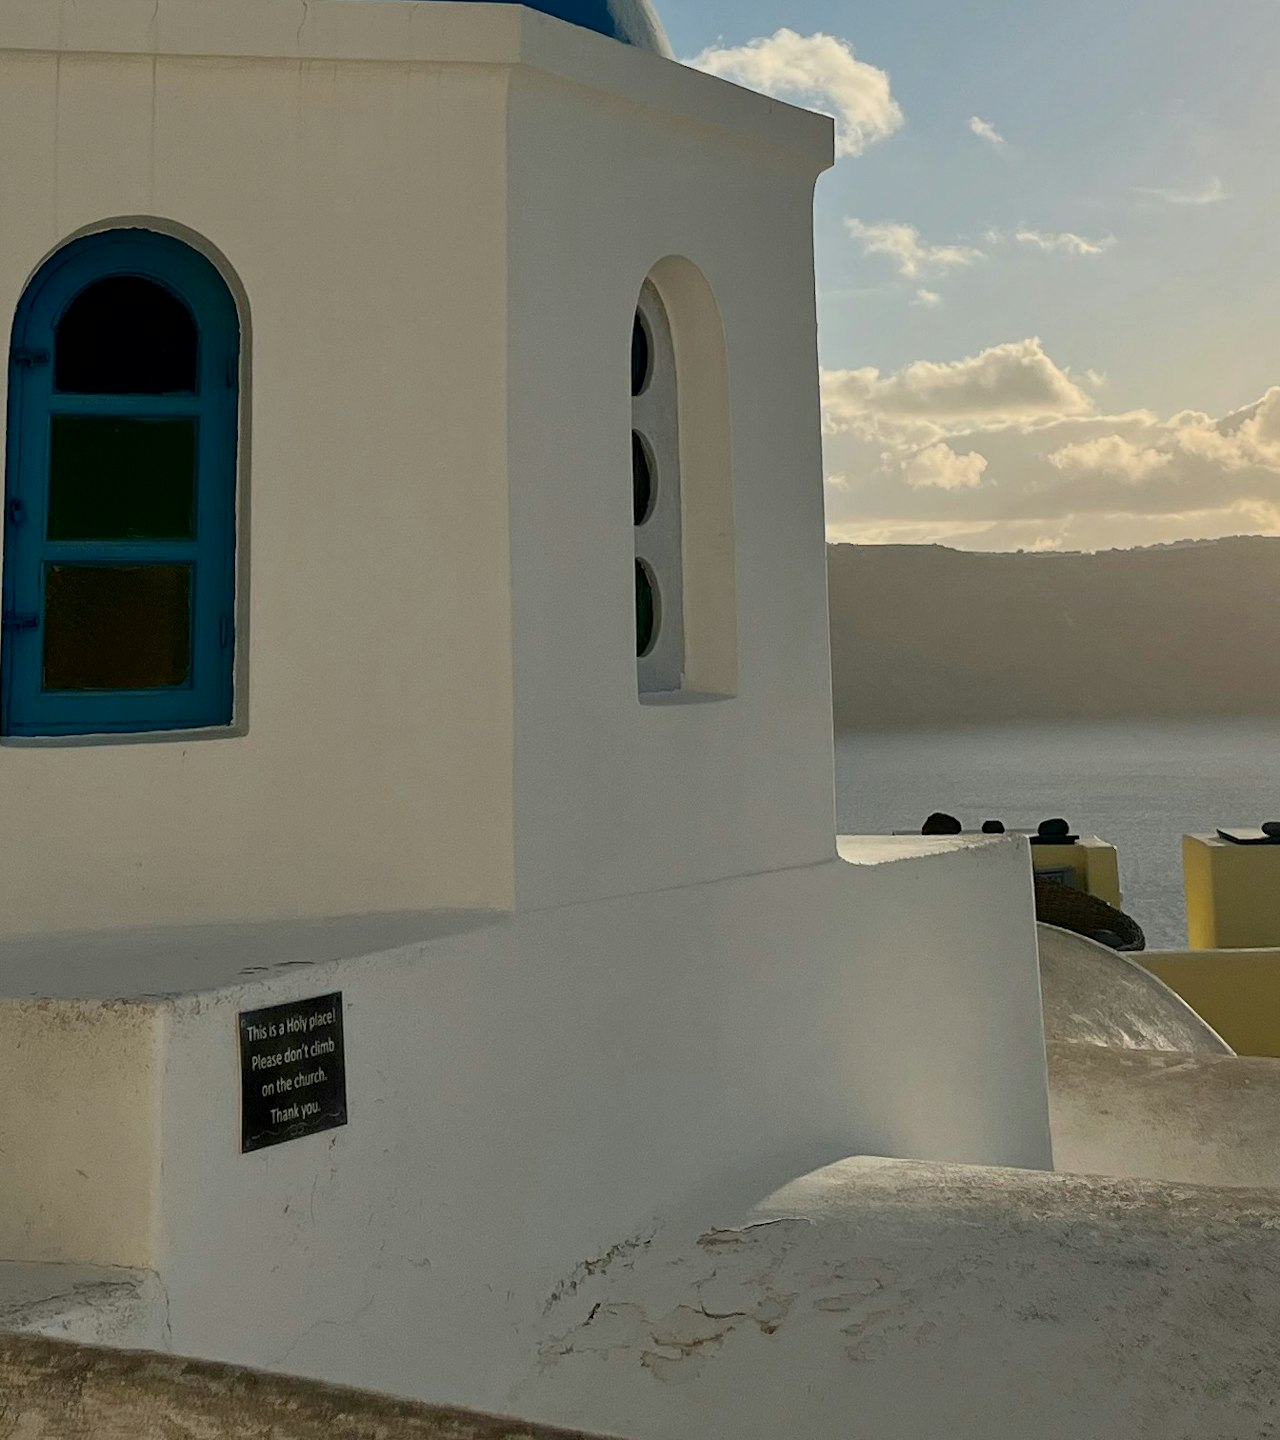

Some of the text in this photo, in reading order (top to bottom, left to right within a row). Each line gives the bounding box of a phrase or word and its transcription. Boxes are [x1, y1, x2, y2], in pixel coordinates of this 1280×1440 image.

[246, 1007, 335, 1043] This is a Holy place!
[251, 1037, 335, 1072] Please don't climb
[261, 1067, 328, 1097] on the church.
[270, 1100, 321, 1124] Thank you.
